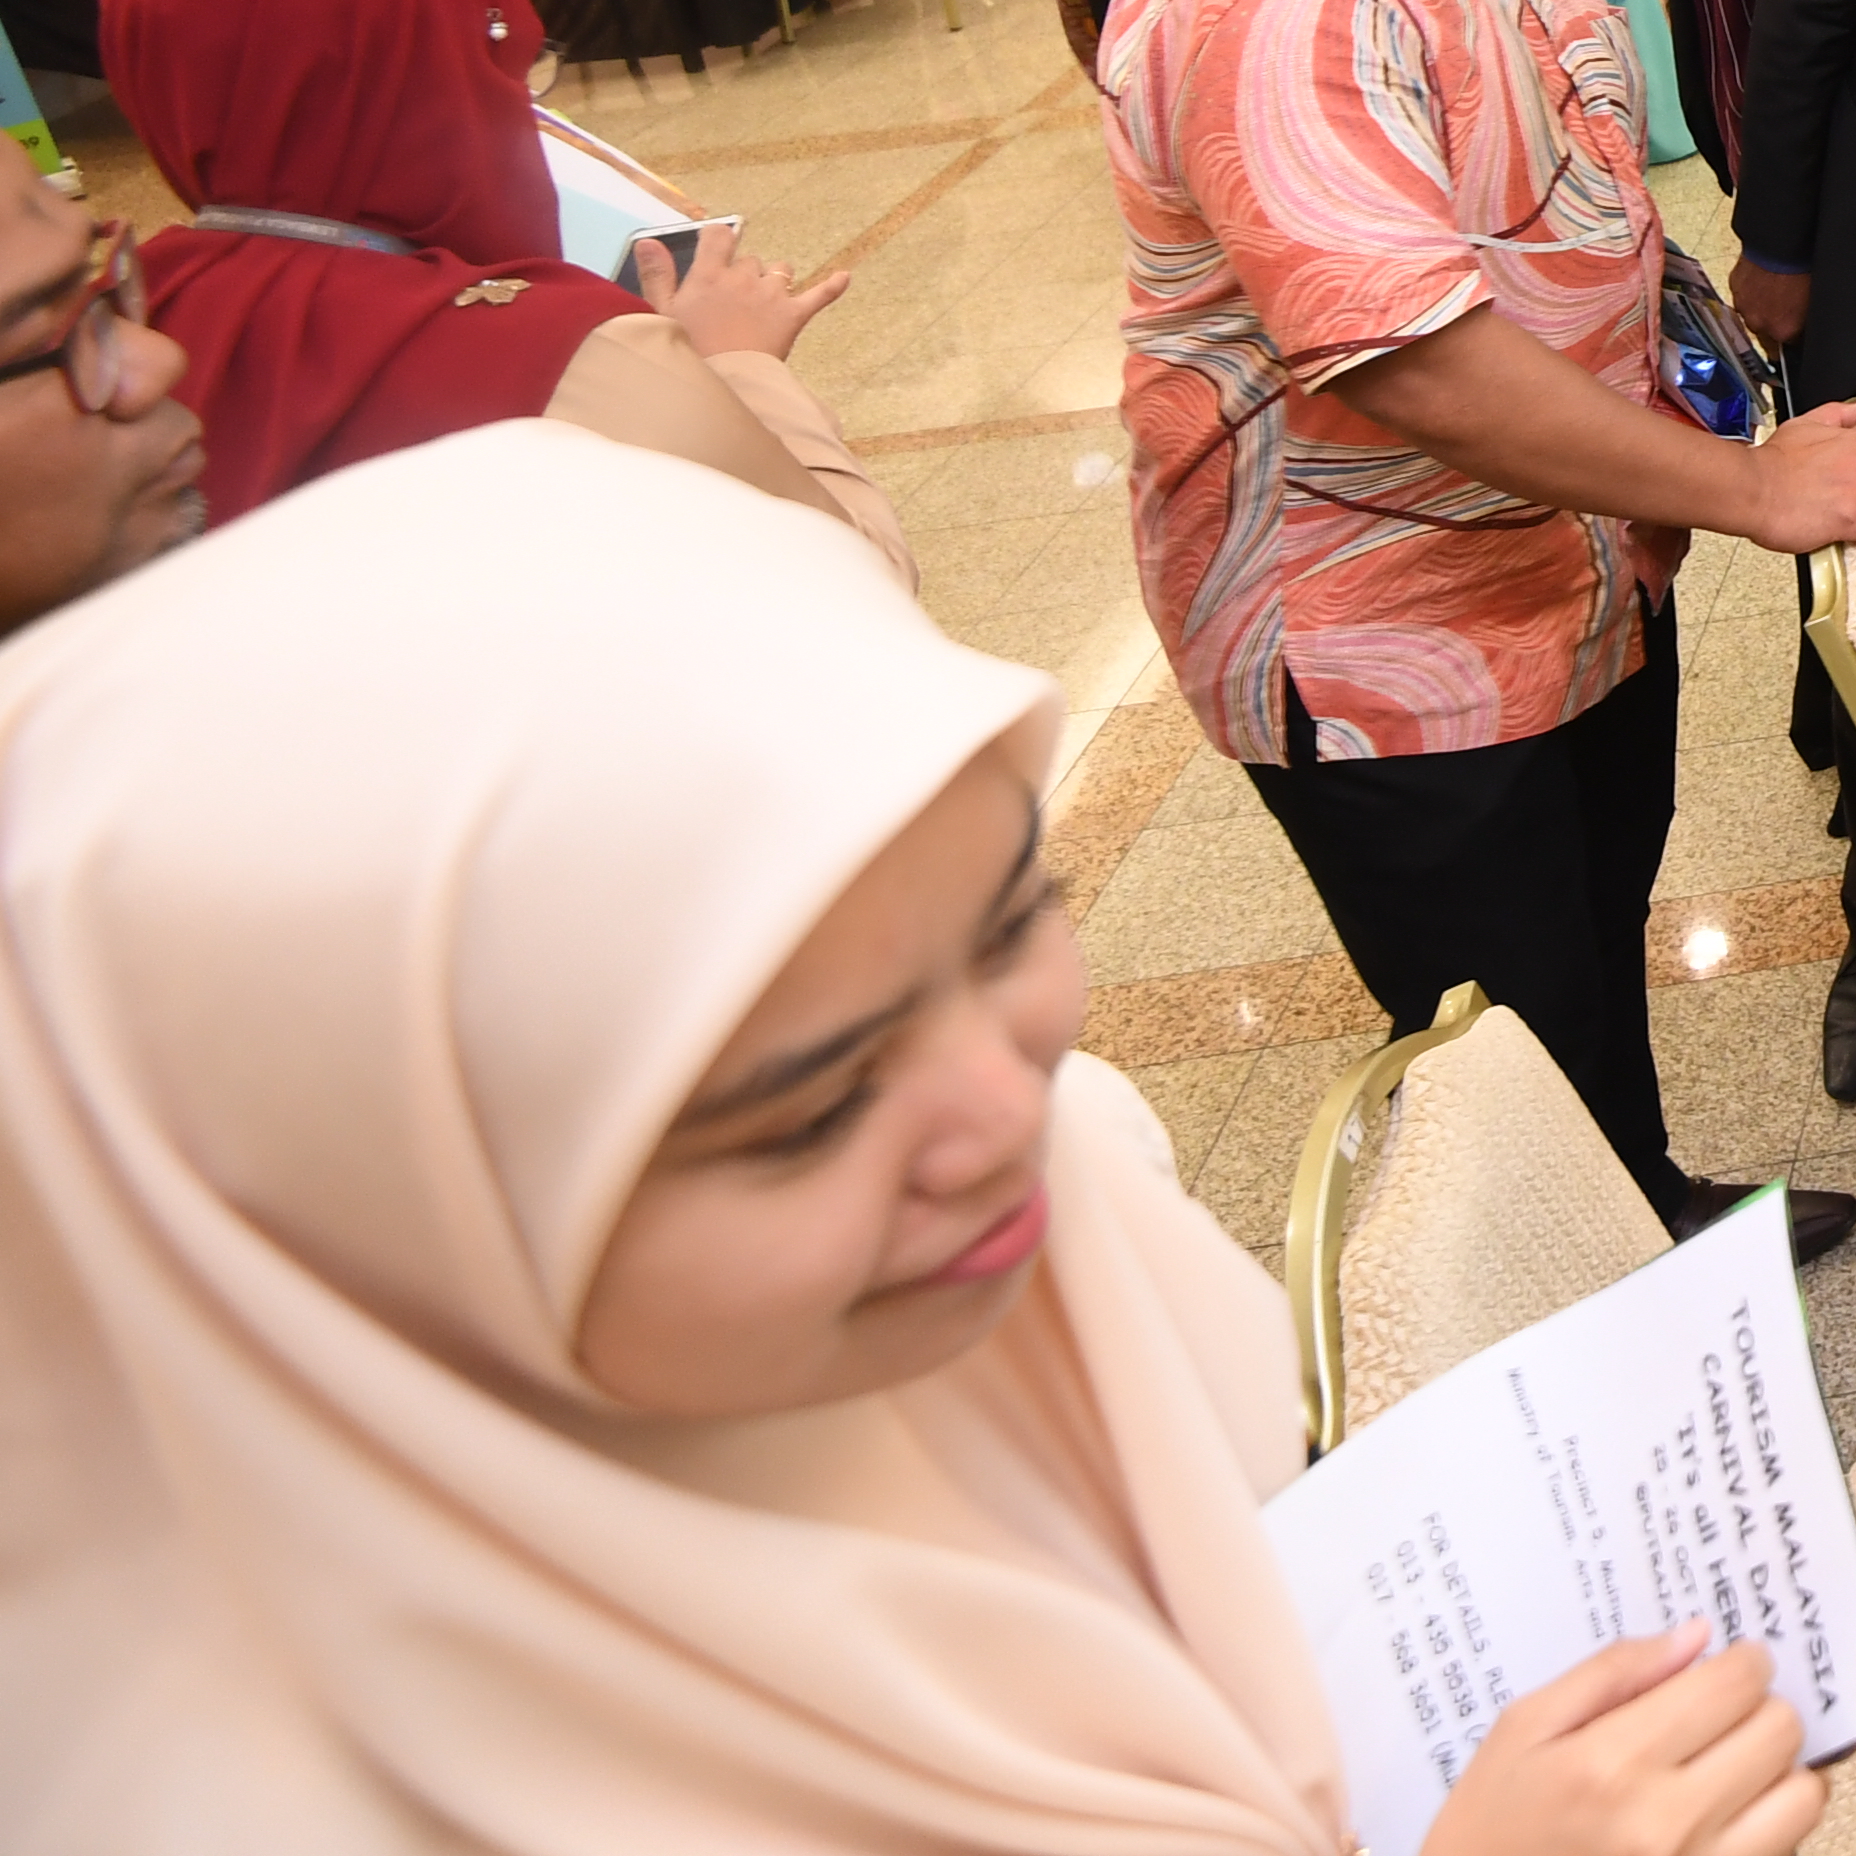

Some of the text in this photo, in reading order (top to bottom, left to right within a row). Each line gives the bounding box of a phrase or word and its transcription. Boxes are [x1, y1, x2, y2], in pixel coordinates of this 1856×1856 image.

[1506, 1366, 1540, 1439] Ministry
[1535, 1443, 1554, 1464] of
[1575, 1557, 1597, 1604] Arts
[1589, 1606, 1606, 1641] and
[1562, 1433, 1599, 1521] Precinct
[1703, 1352, 1787, 1642] CARNIVAL DAY
[1731, 1299, 1839, 1717] TOURISM MALAYSIA
[1422, 1511, 1452, 1559] FOR
[1694, 1501, 1721, 1546] all
[1368, 1561, 1396, 1604] 017
[1396, 1539, 1426, 1586] 013
[1422, 1612, 1454, 1657] 435
[1674, 1544, 1698, 1596] OCT
